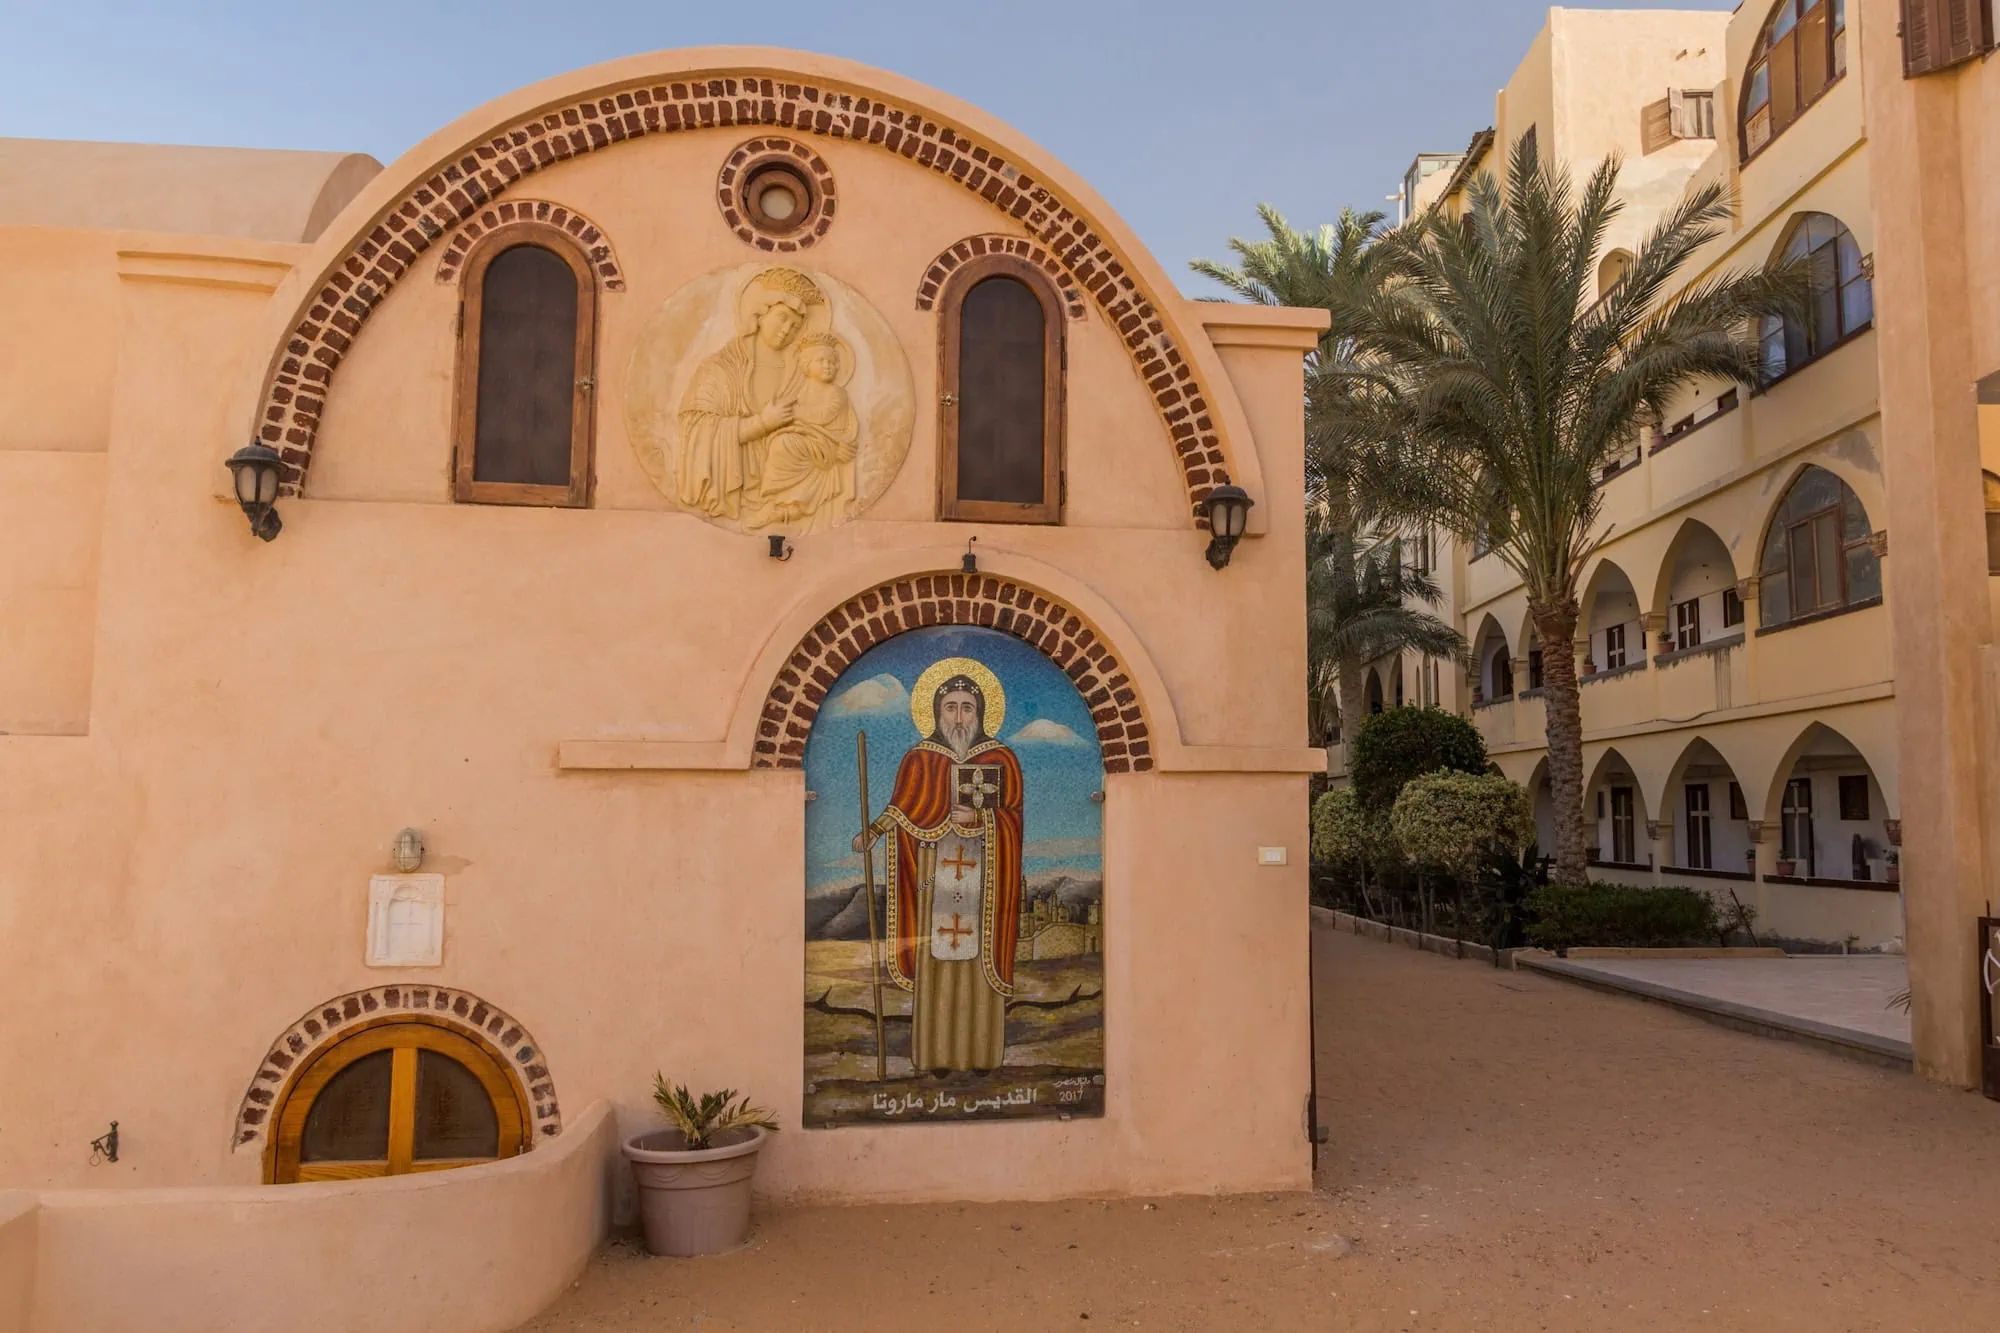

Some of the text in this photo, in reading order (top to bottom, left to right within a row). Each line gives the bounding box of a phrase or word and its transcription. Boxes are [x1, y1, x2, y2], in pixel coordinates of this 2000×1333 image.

[872, 1088, 1038, 1115] القديس مار ماروتا
[1059, 1090, 1084, 1102] 2017
